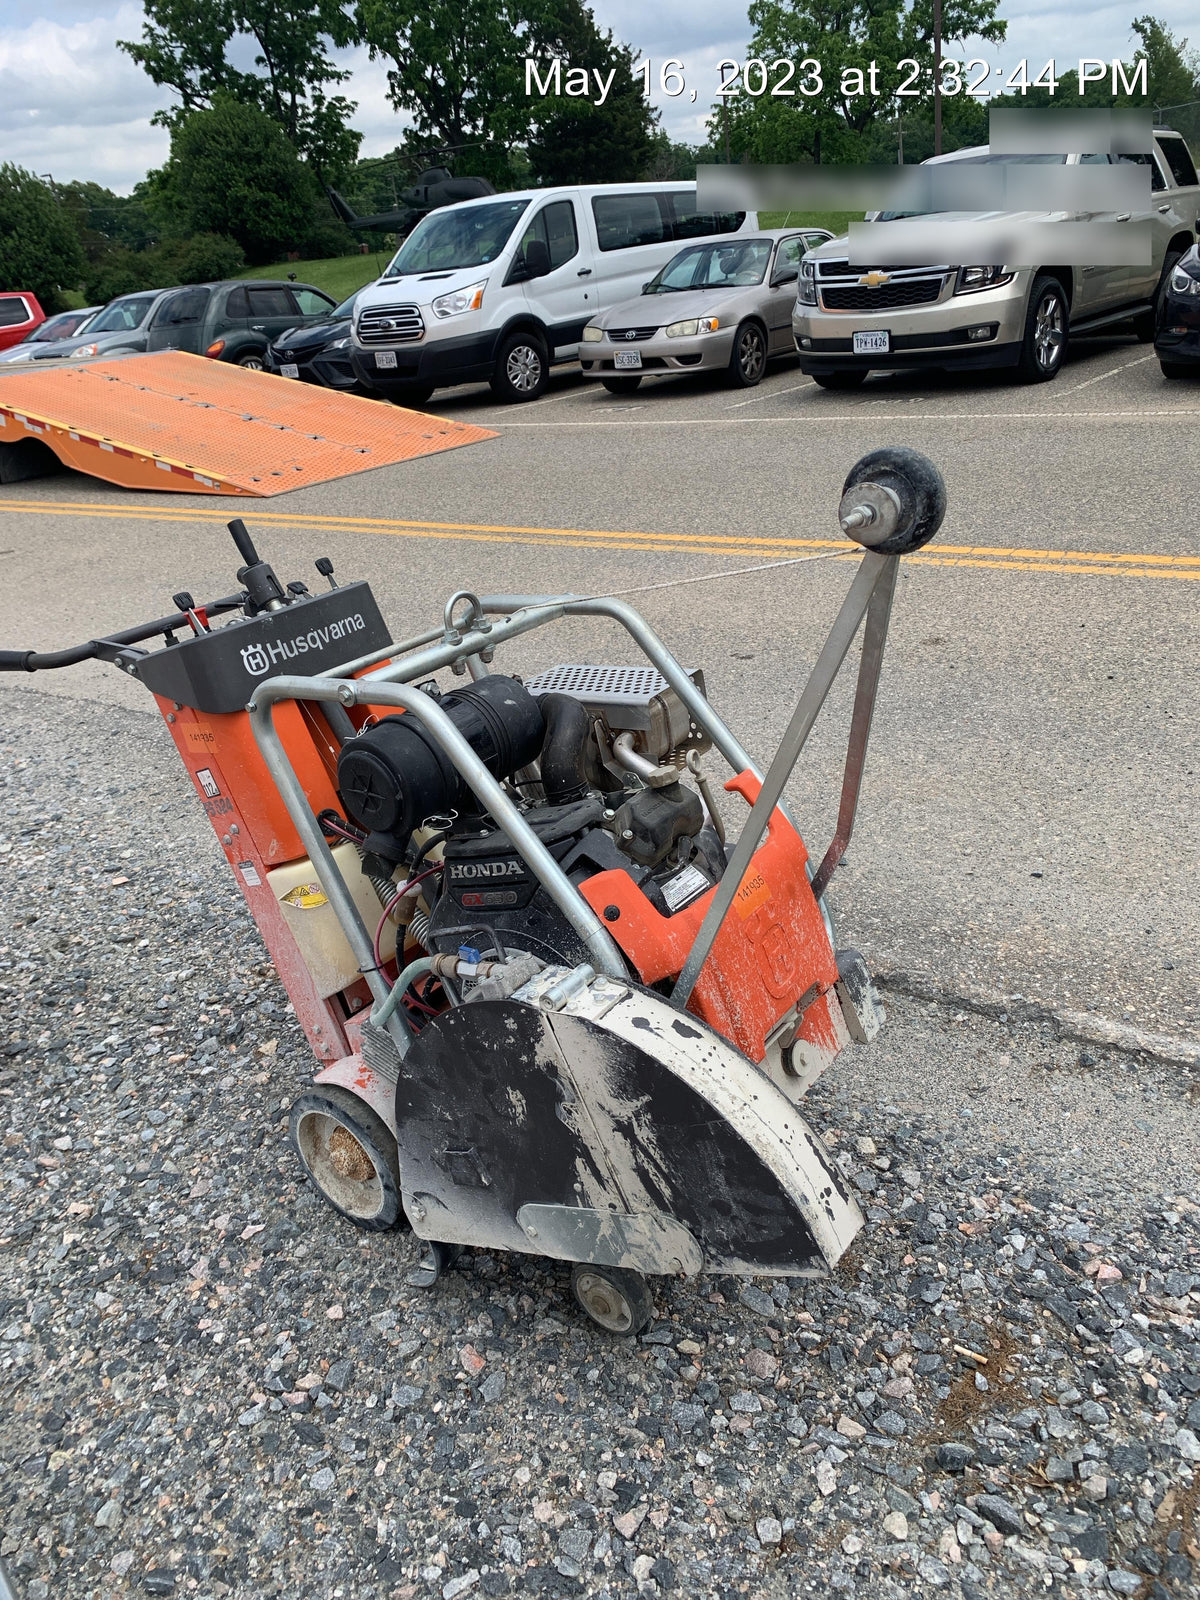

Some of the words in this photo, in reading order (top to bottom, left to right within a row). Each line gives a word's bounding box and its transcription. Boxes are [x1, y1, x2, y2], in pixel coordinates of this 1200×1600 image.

[266, 613, 366, 664] Husqvarna
[450, 860, 525, 879] HONDA
[737, 874, 765, 902] 141935
